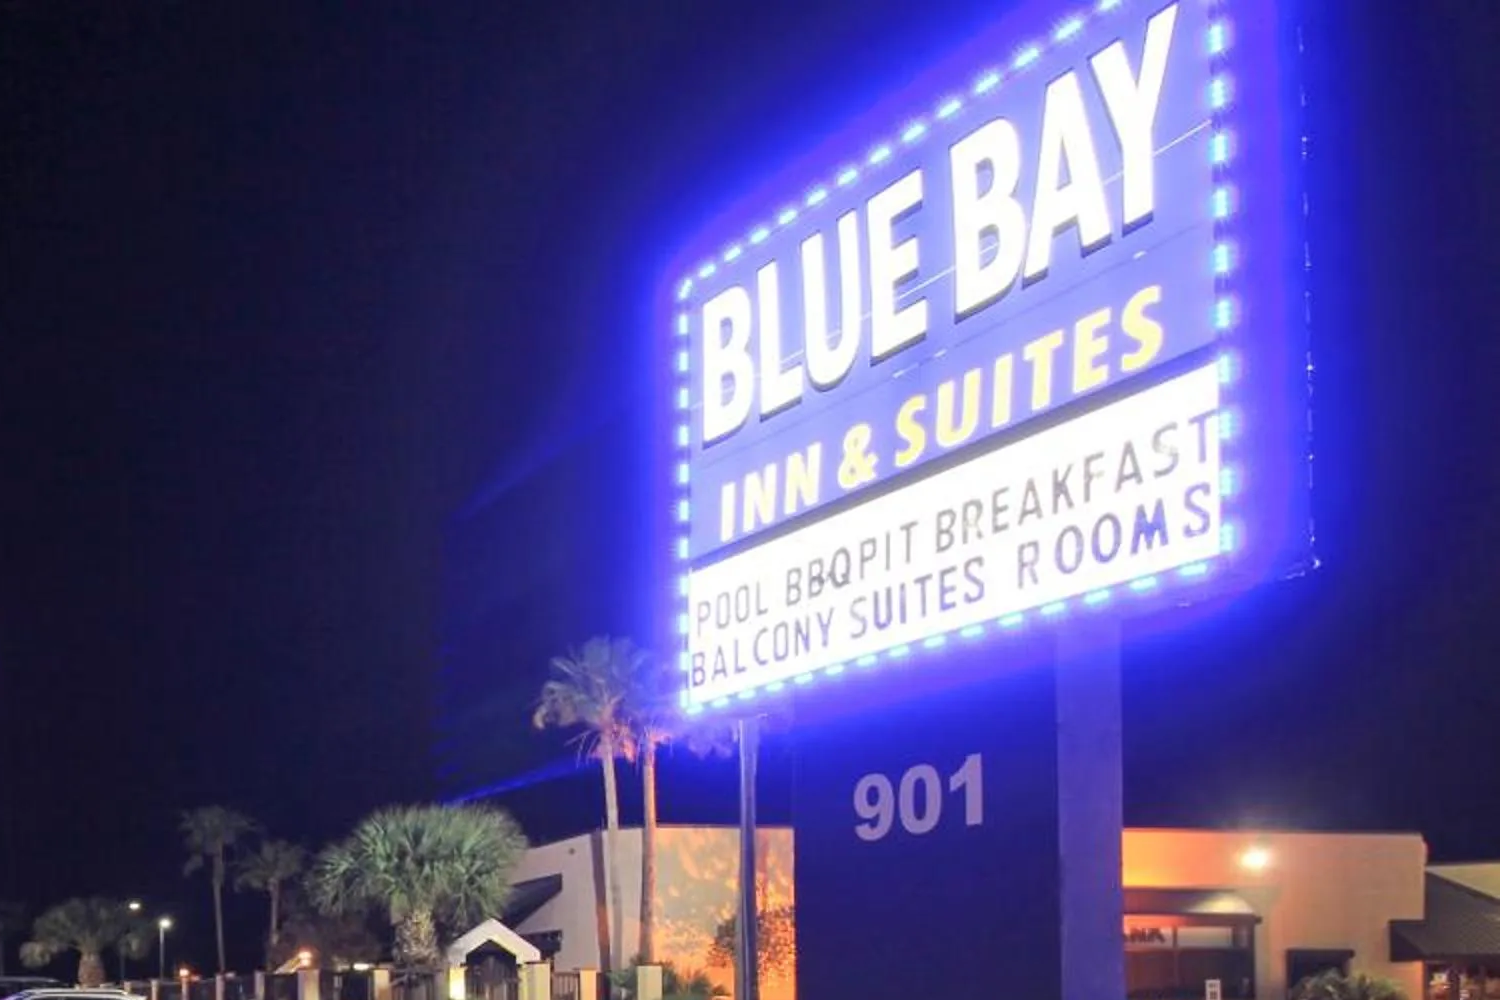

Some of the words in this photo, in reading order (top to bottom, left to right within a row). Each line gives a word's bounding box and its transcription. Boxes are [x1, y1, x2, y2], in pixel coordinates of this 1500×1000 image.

[701, 168, 927, 447] BLUE
[948, 1, 1179, 323] BAY
[697, 581, 769, 638] POOL
[934, 408, 1219, 553] BREAKFAST
[719, 451, 822, 542] INN
[837, 424, 878, 489] &
[894, 285, 1164, 469] SUITES
[691, 606, 835, 688] BALCONY
[850, 556, 986, 640] SUITES
[1016, 481, 1212, 590] ROOMS
[853, 752, 983, 841] 901
